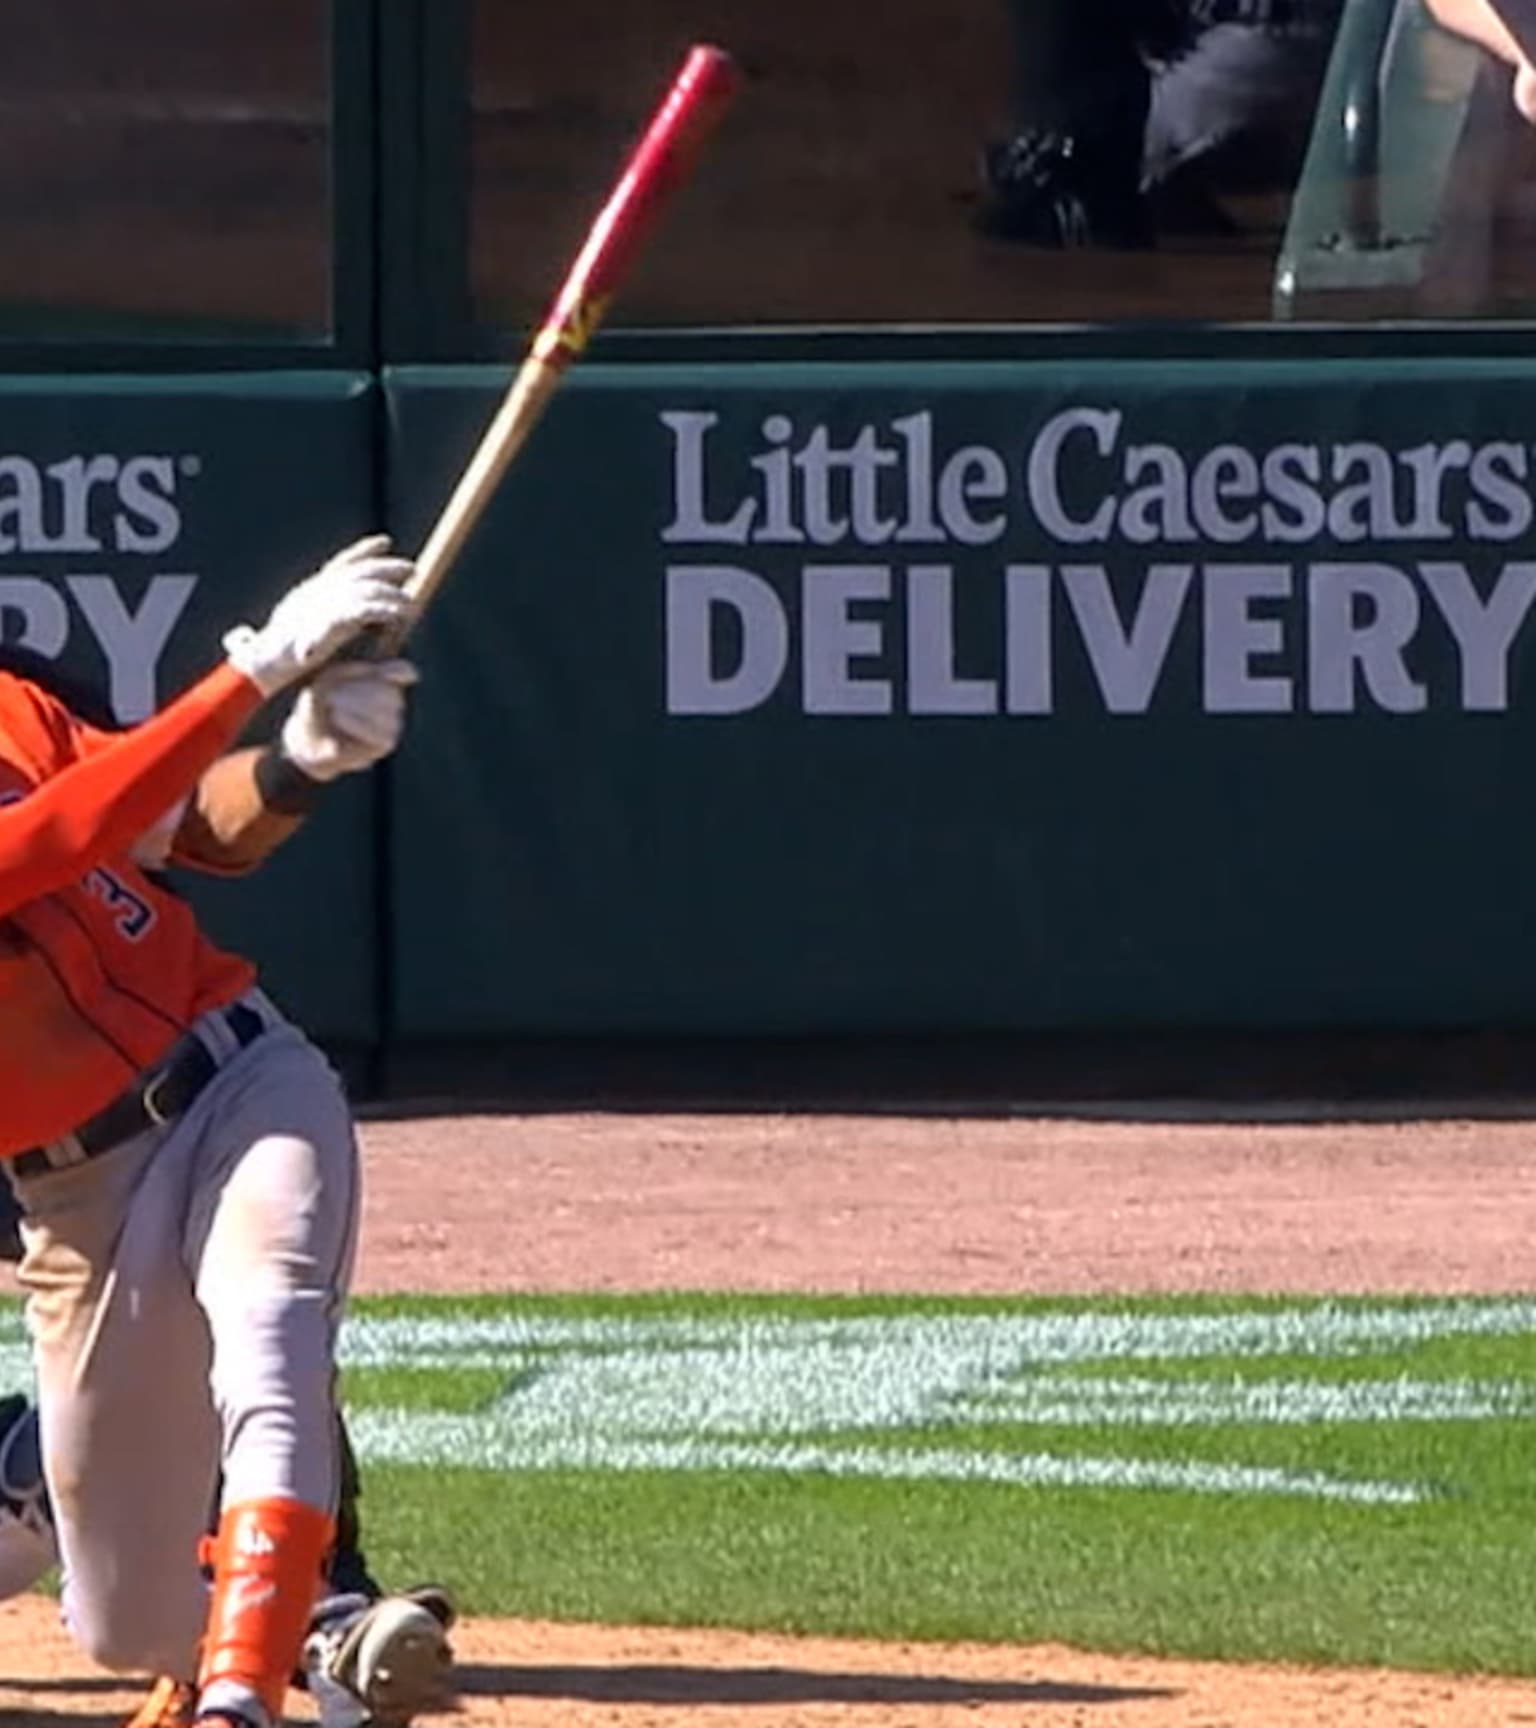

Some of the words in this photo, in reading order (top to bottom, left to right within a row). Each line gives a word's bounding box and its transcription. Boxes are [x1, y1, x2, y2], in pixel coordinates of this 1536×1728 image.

[660, 411, 1008, 544] Little
[1027, 407, 1533, 543] Caesars
[666, 561, 1536, 715] DELIVERY
[80, 863, 158, 942] 3
